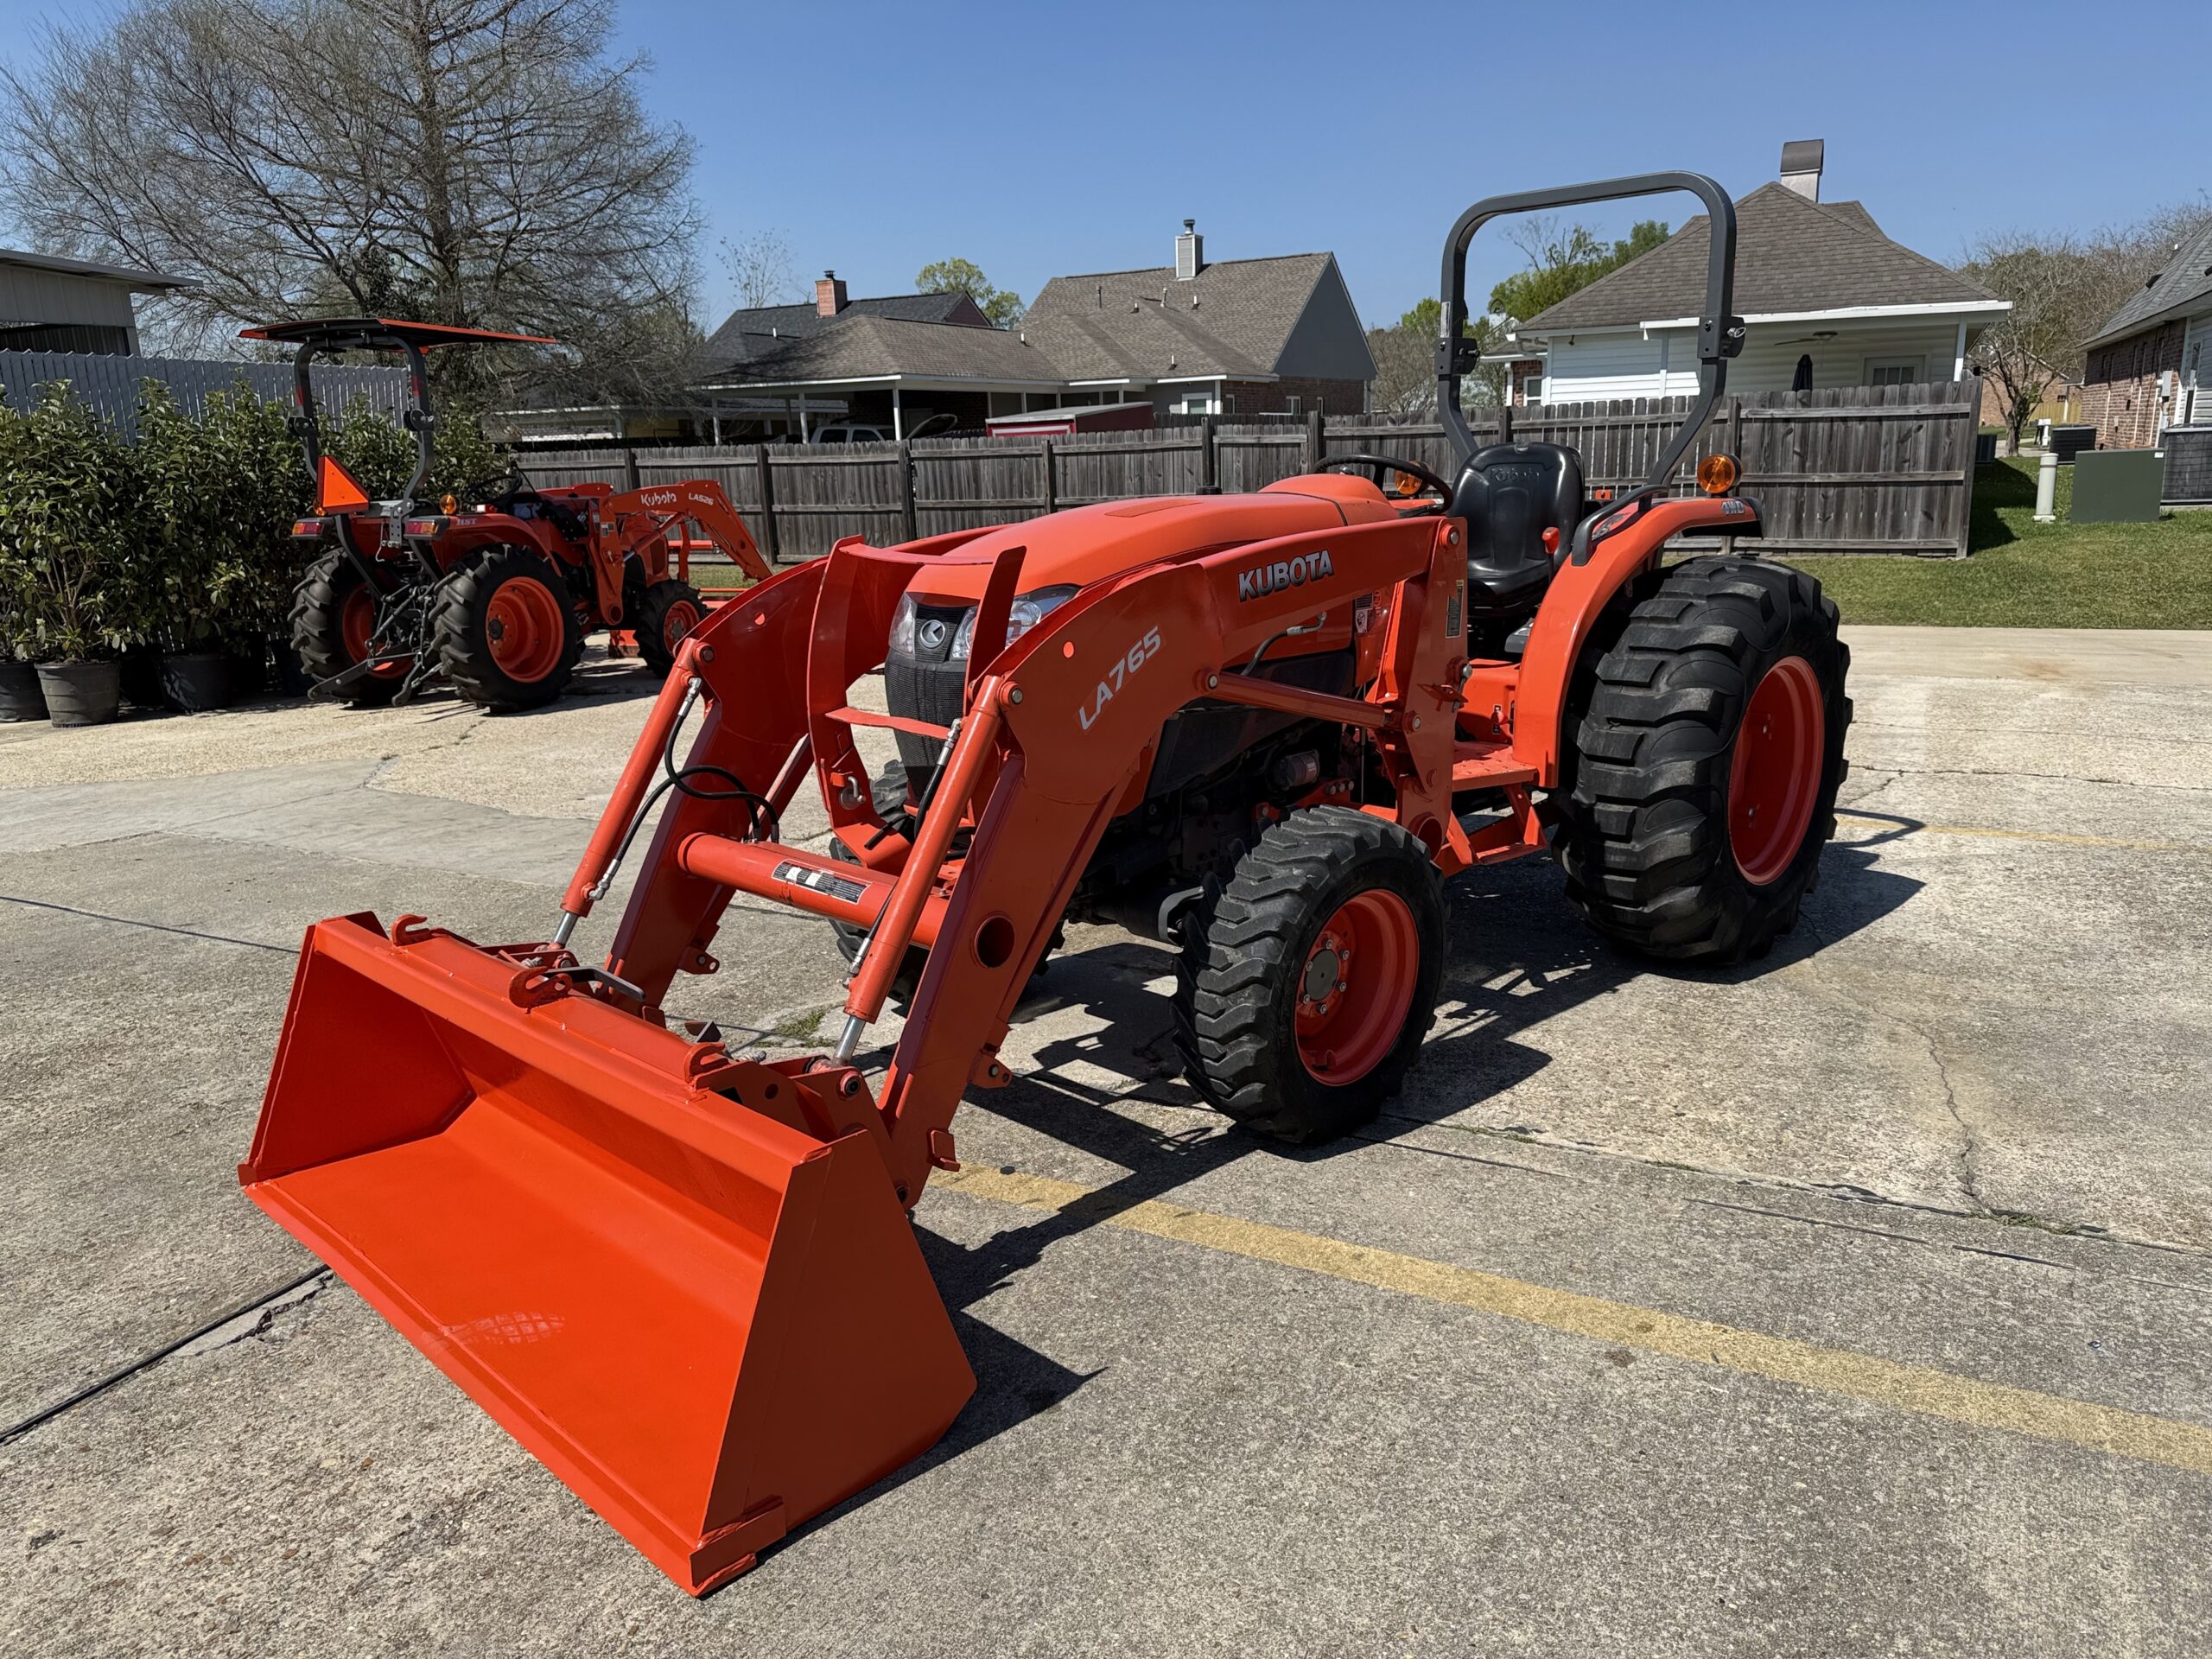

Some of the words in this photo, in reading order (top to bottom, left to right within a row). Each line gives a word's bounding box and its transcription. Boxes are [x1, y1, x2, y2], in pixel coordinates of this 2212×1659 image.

[640, 491, 677, 506] Kubota
[688, 493, 714, 505] LA526
[1721, 500, 1745, 514] 4WD
[1238, 549, 1334, 602] KUBOTA
[1078, 625, 1161, 730] LA765
